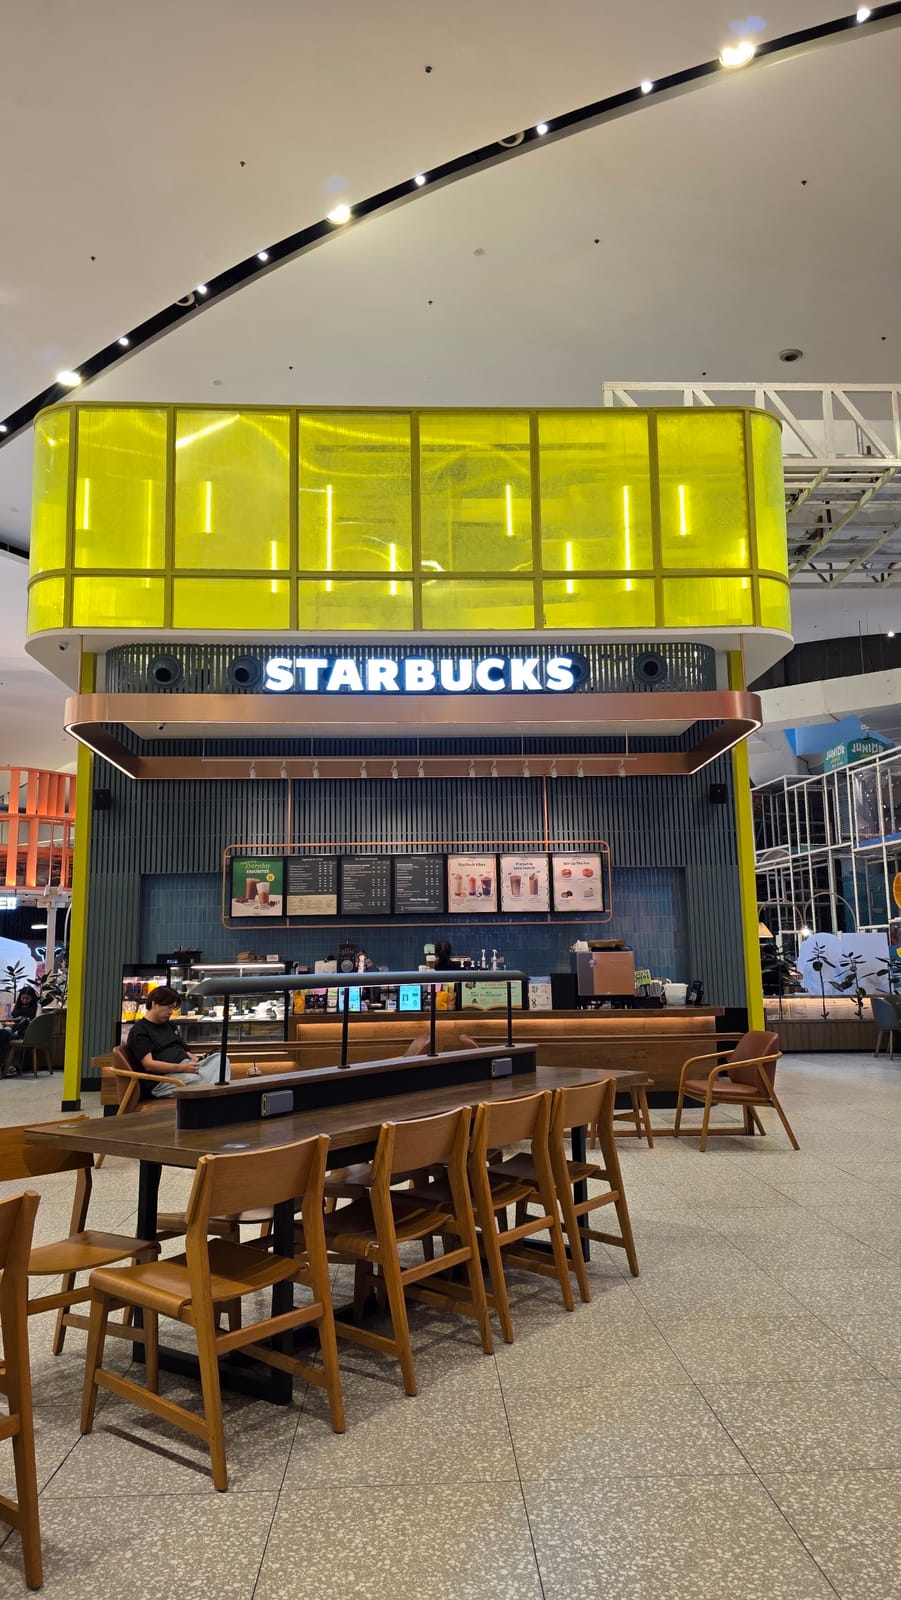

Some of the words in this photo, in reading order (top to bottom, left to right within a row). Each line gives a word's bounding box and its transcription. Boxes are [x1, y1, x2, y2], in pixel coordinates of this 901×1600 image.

[264, 657, 575, 692] STARBUCKS
[826, 744, 845, 760] JUNIOR
[851, 742, 884, 754] JUNIOR
